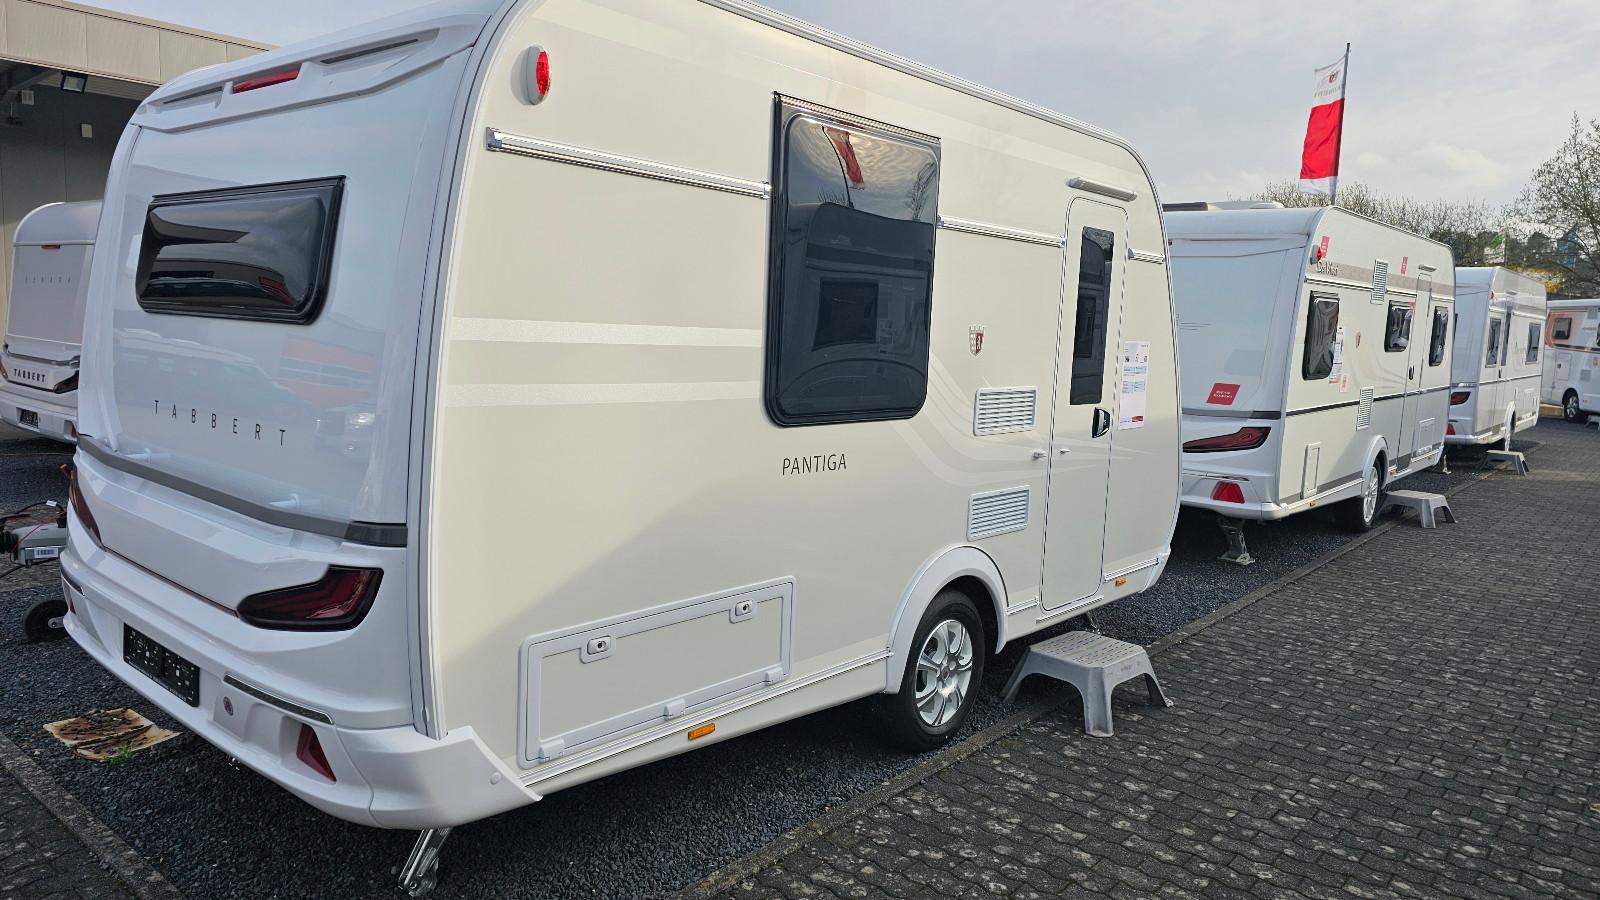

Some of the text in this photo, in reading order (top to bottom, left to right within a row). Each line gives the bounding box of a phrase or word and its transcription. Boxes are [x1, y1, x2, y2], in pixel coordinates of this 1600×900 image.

[13, 368, 46, 383] TABBERT
[154, 399, 286, 447] TABBERT
[782, 453, 847, 476] PANTIGA
